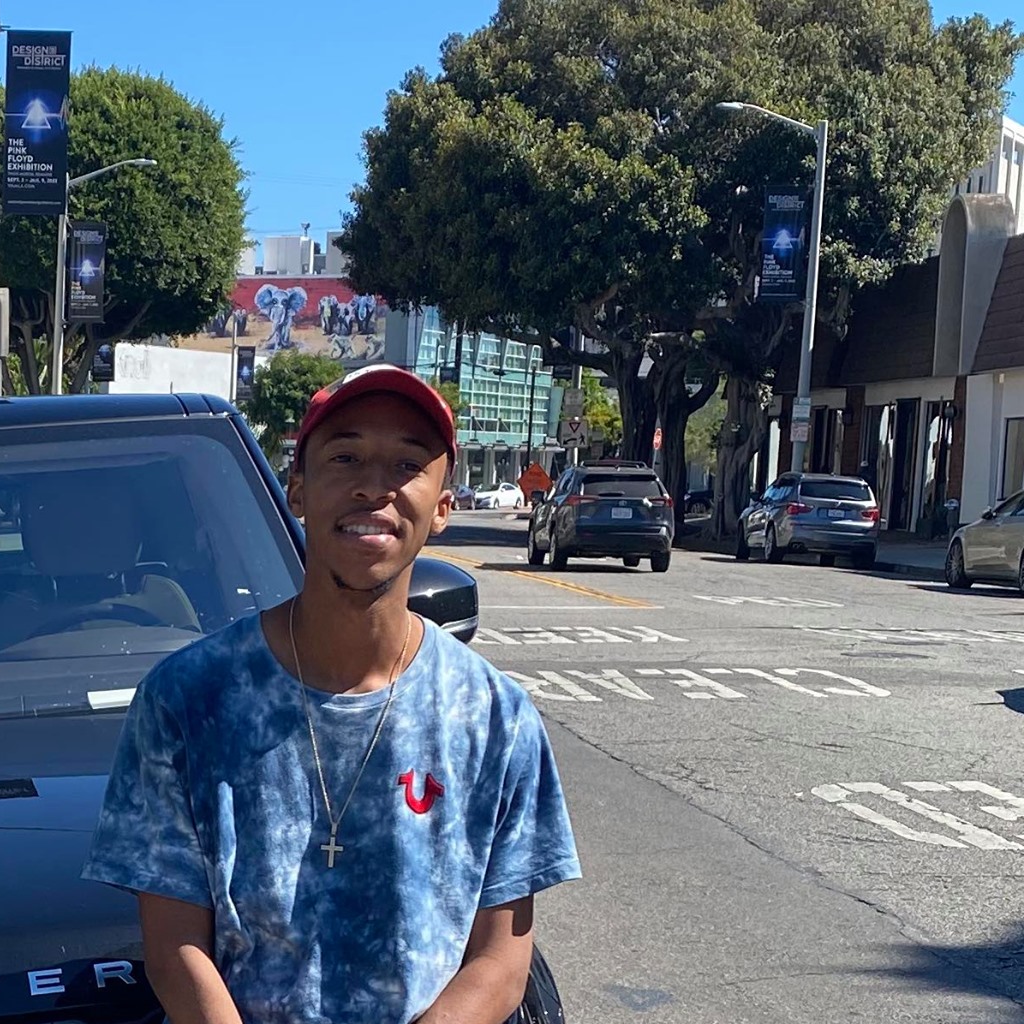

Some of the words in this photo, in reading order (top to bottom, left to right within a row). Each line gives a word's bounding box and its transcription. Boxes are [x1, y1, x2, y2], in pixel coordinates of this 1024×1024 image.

[12, 45, 49, 55] DESIGN
[24, 55, 66, 66] DISTRICT
[8, 138, 24, 146] THE
[7, 163, 53, 171] EXHIBITION
[473, 626, 689, 645] KEEP
[503, 668, 892, 701] CLEAR
